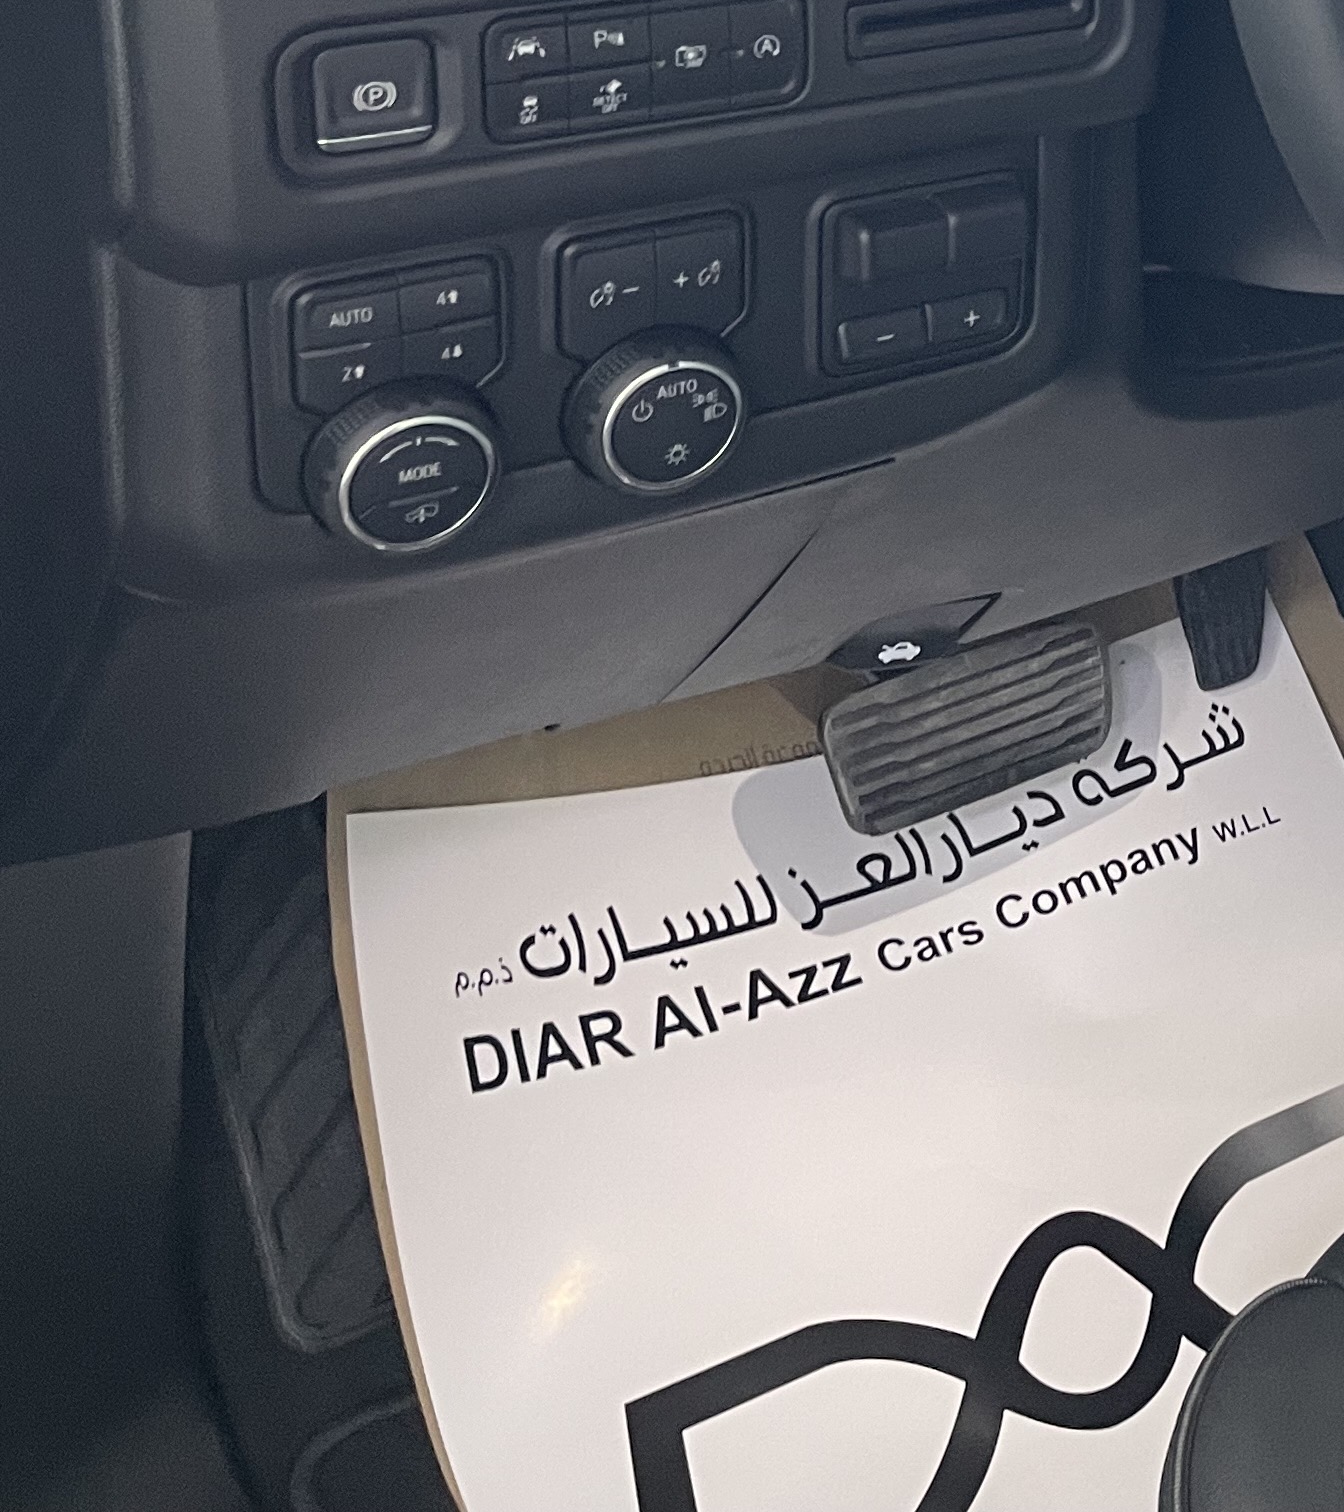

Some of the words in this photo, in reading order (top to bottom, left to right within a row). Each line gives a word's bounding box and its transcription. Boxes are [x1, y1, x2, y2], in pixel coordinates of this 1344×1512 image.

[329, 306, 374, 328] AUTO
[656, 378, 698, 400] AUTO
[399, 461, 442, 483] MODE
[1071, 702, 1246, 806] شركة
[787, 825, 934, 930] العز
[942, 788, 1066, 884] ديار
[463, 1009, 636, 1094] DIAR
[653, 952, 863, 1050] Al-Azz
[877, 917, 985, 973] Cars
[995, 826, 1201, 929] Company
[1211, 805, 1282, 844] W.L.L
[519, 872, 778, 986] للسيارات
